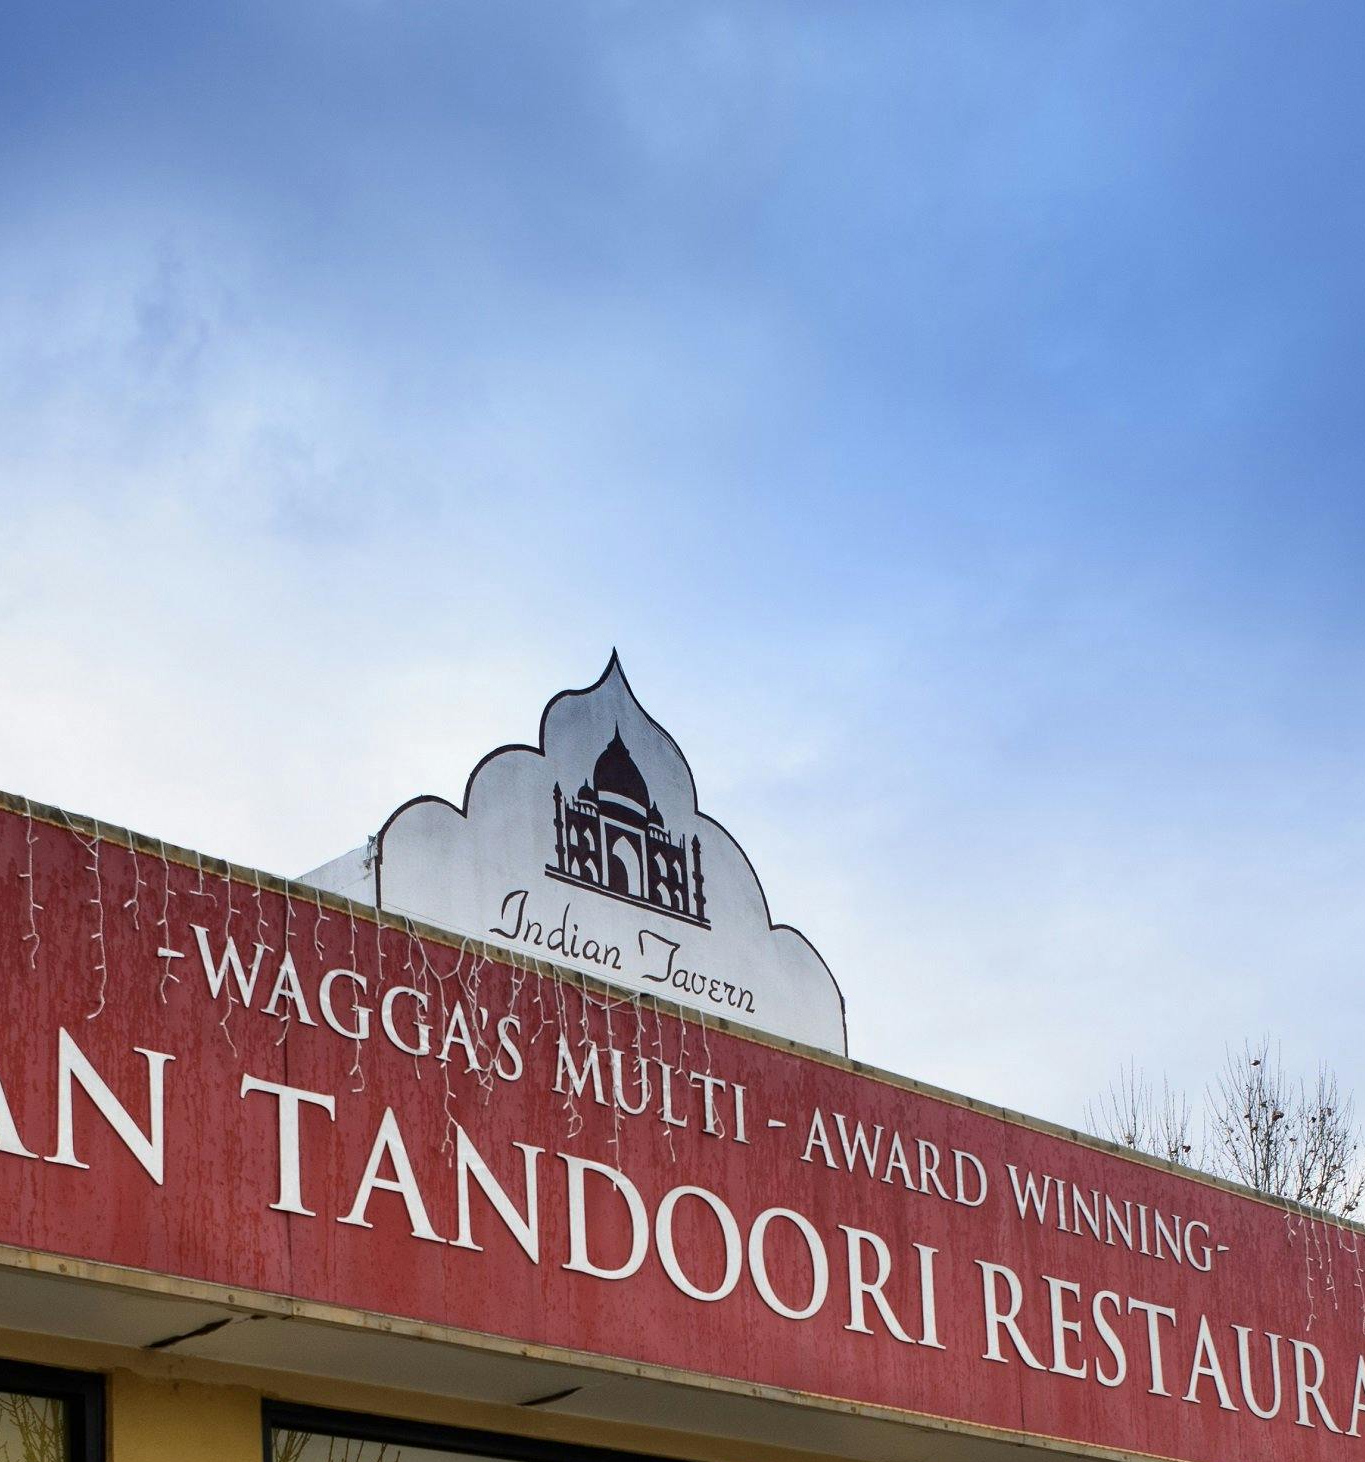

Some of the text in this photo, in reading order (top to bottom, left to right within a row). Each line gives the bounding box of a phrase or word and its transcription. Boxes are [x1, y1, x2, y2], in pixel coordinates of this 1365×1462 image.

[489, 890, 756, 1016] Indian Tavern
[551, 1036, 750, 1145] MULTI
[800, 1107, 989, 1207] AWARD
[239, 1072, 947, 1351] TANDOORI
